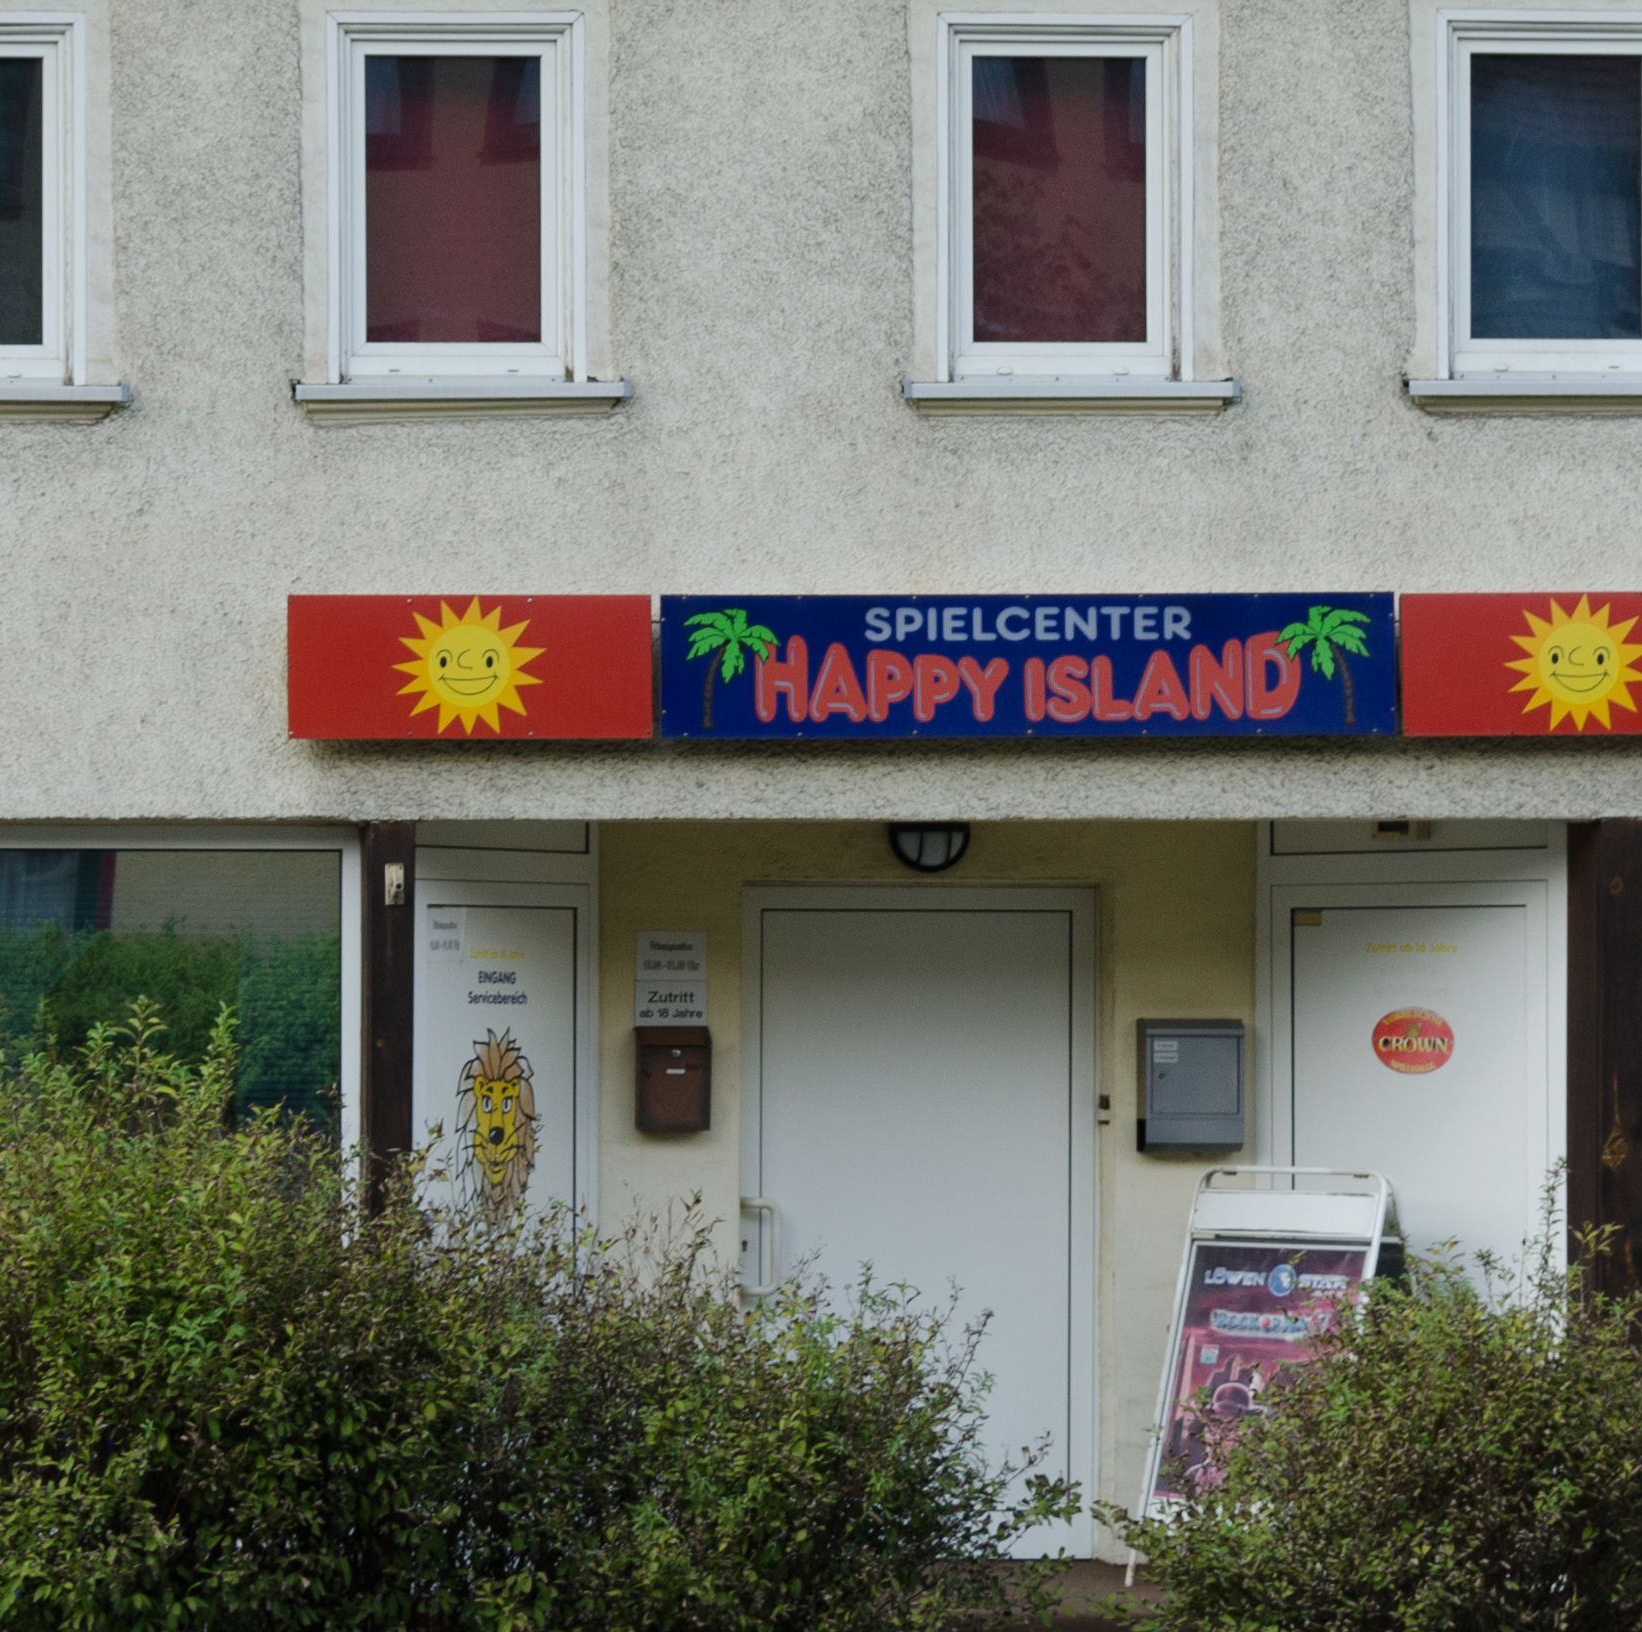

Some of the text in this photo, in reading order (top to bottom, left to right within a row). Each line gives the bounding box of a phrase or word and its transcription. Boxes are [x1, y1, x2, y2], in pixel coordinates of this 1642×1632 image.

[864, 606, 1192, 642] SPIELCENTER
[754, 630, 1302, 723] HAPPY ISLAND
[478, 970, 517, 984] EINGANG
[468, 990, 528, 1005] Servicebereich
[647, 990, 695, 1004] Zutritt
[639, 1007, 704, 1019] ab 18 Jahre
[1378, 1035, 1449, 1054] CROWN
[1203, 1266, 1268, 1287] LÖWEN
